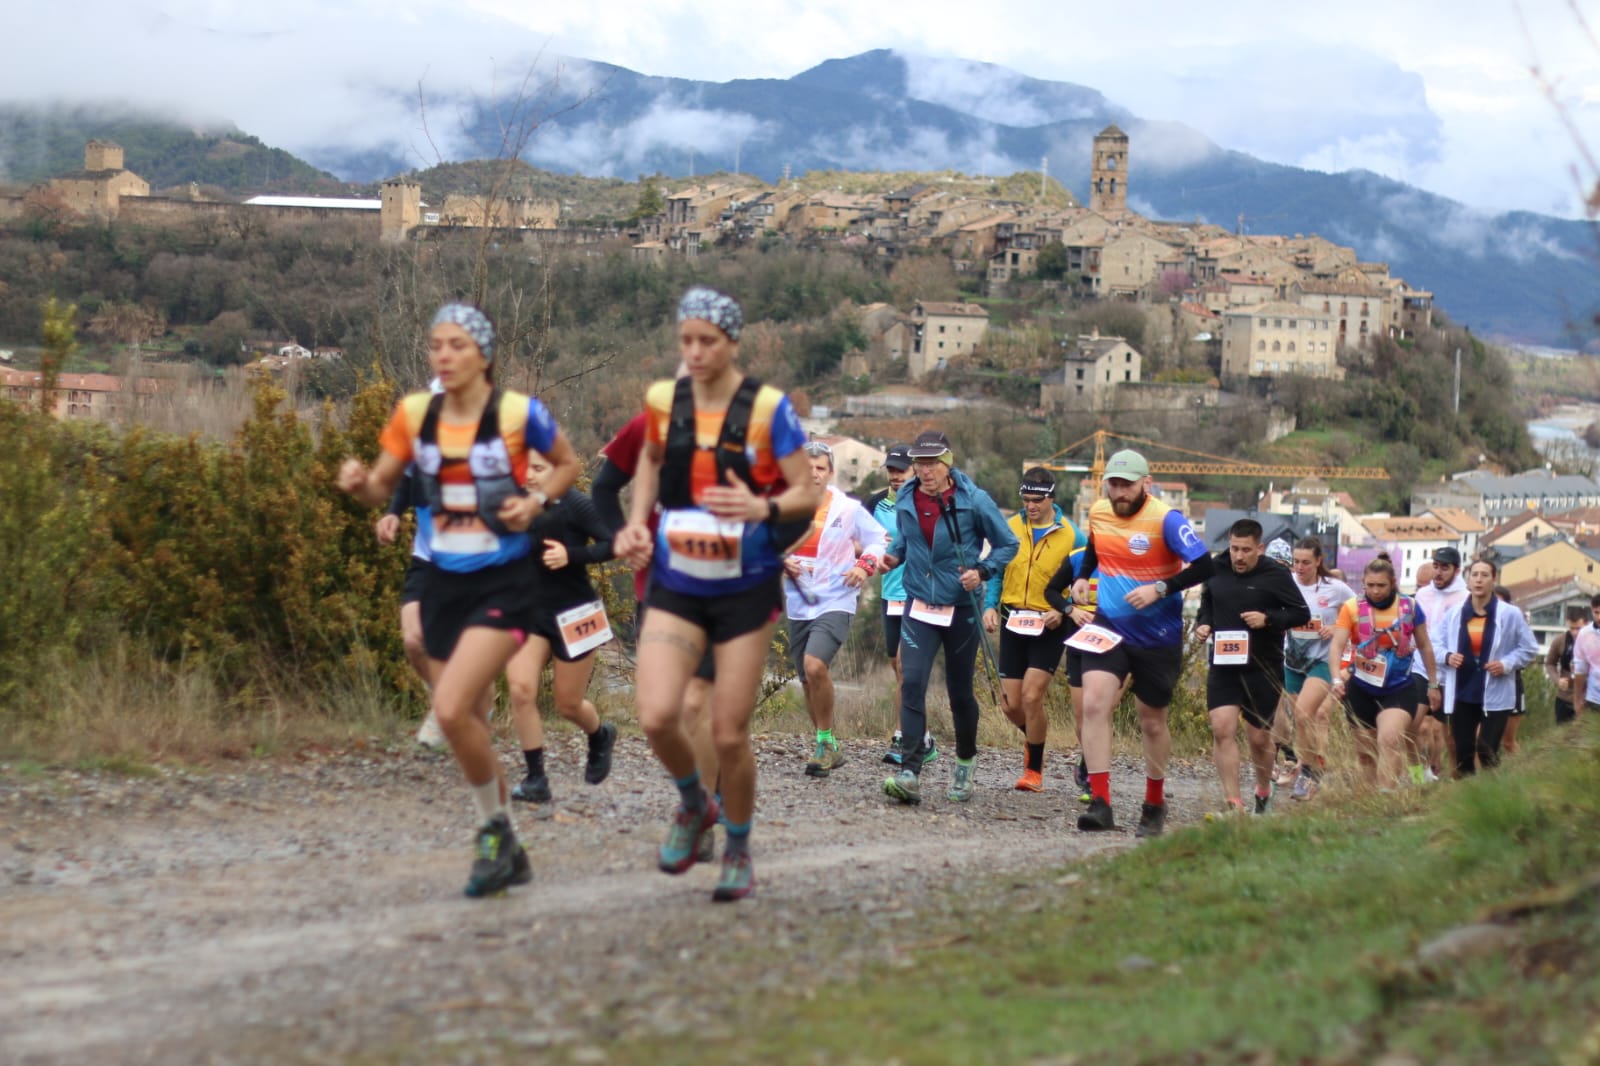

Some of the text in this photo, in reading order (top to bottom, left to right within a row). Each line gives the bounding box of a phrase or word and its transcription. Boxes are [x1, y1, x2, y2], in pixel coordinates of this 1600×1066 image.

[574, 618, 597, 636] 171
[1018, 618, 1035, 628] 195
[1222, 643, 1240, 653] 235
